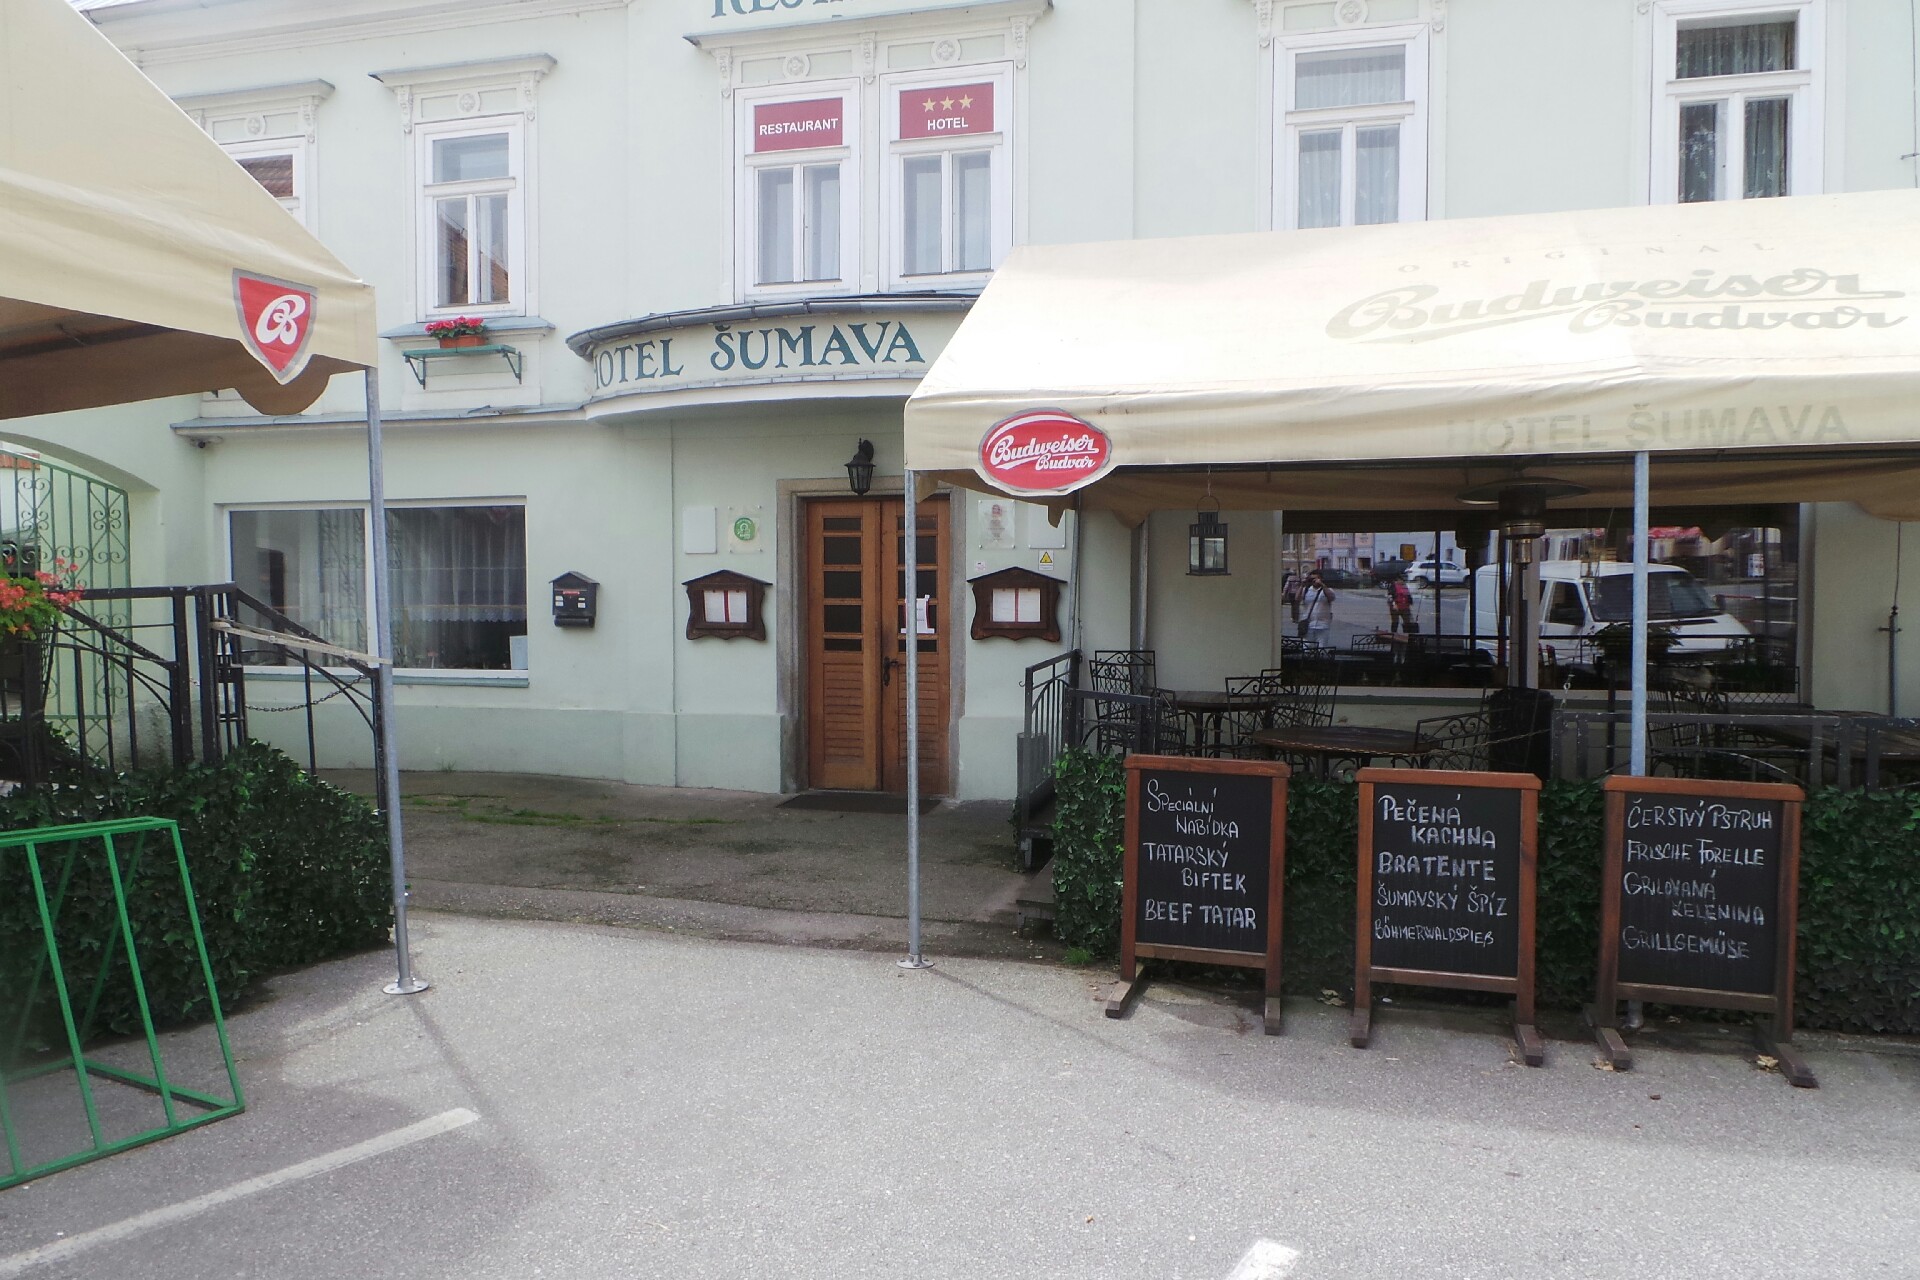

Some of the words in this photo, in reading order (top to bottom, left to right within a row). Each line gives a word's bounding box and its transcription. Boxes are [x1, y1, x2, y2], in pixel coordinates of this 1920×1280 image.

[759, 118, 839, 135] RESTAURANT
[927, 116, 969, 131] HOTEL
[1398, 243, 1776, 273] ORIGINAL
[1325, 267, 1906, 341] Budweiser
[1568, 299, 1909, 335] Budvar
[710, 321, 926, 371] ŠUMAVA
[1447, 413, 1609, 455] HOTEL
[1625, 403, 1851, 449] ŠUMAVA
[990, 434, 1100, 467] Budweiser
[1035, 452, 1096, 471] Budvar
[1378, 793, 1462, 826] PEČENÁ
[1627, 798, 1706, 829] ČERSTVÝ
[1707, 803, 1774, 831] PSTRUH
[1176, 815, 1240, 839] NABÍDKA
[1411, 825, 1497, 850] KACHNA
[1143, 841, 1229, 868] TATARSKÝ
[1378, 851, 1497, 882] BRATENTE
[1627, 839, 1693, 863] FRISCHE
[1695, 838, 1765, 866] FORELLE
[1182, 867, 1247, 895] BIFTEK
[1376, 880, 1459, 912] ŠUMAVSKÝ
[1623, 869, 1718, 901] GRILOVANÁ
[1145, 899, 1193, 925] BEEF
[1199, 905, 1257, 930] TATAR
[1622, 925, 1750, 959] GRILLGEMÜSE
